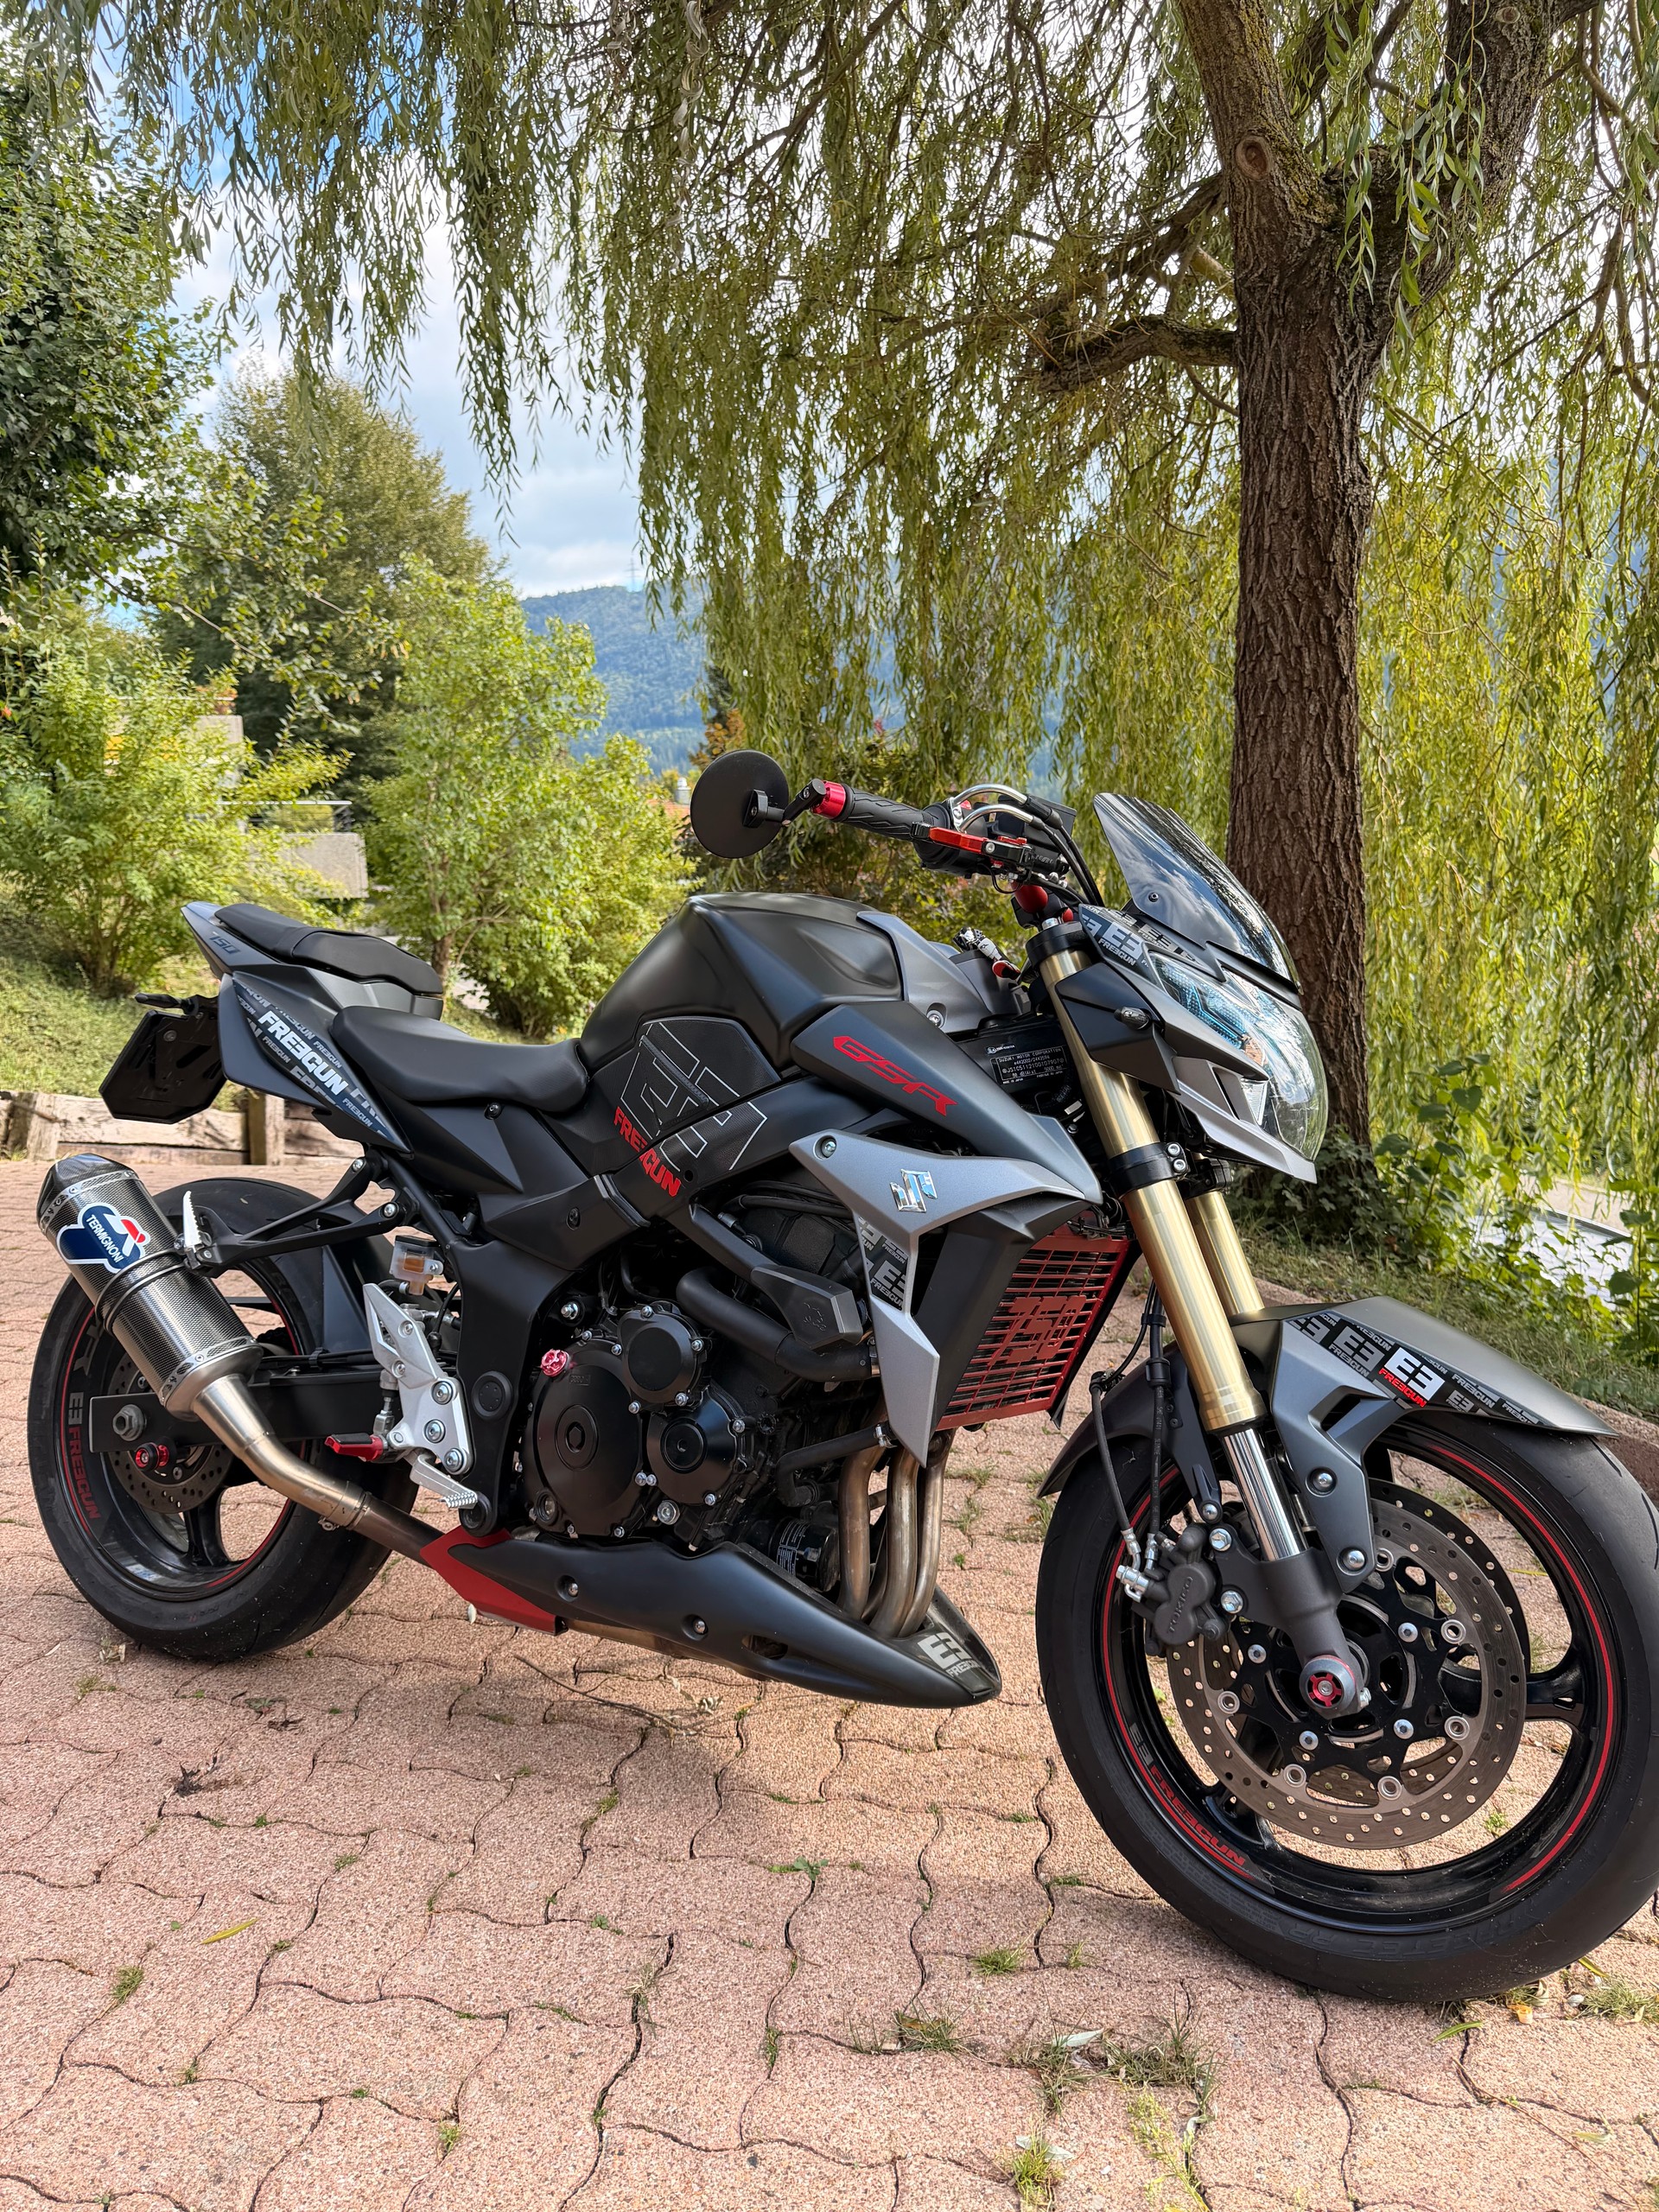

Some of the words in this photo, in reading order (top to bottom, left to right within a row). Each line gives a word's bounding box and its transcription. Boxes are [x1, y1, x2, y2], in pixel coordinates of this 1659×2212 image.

[833, 1035, 958, 1116] GSR
[86, 1214, 124, 1262] TERMIGNONI
[870, 1278, 903, 1307] FREEGU
[1167, 1576, 1193, 1633] TOKICO
